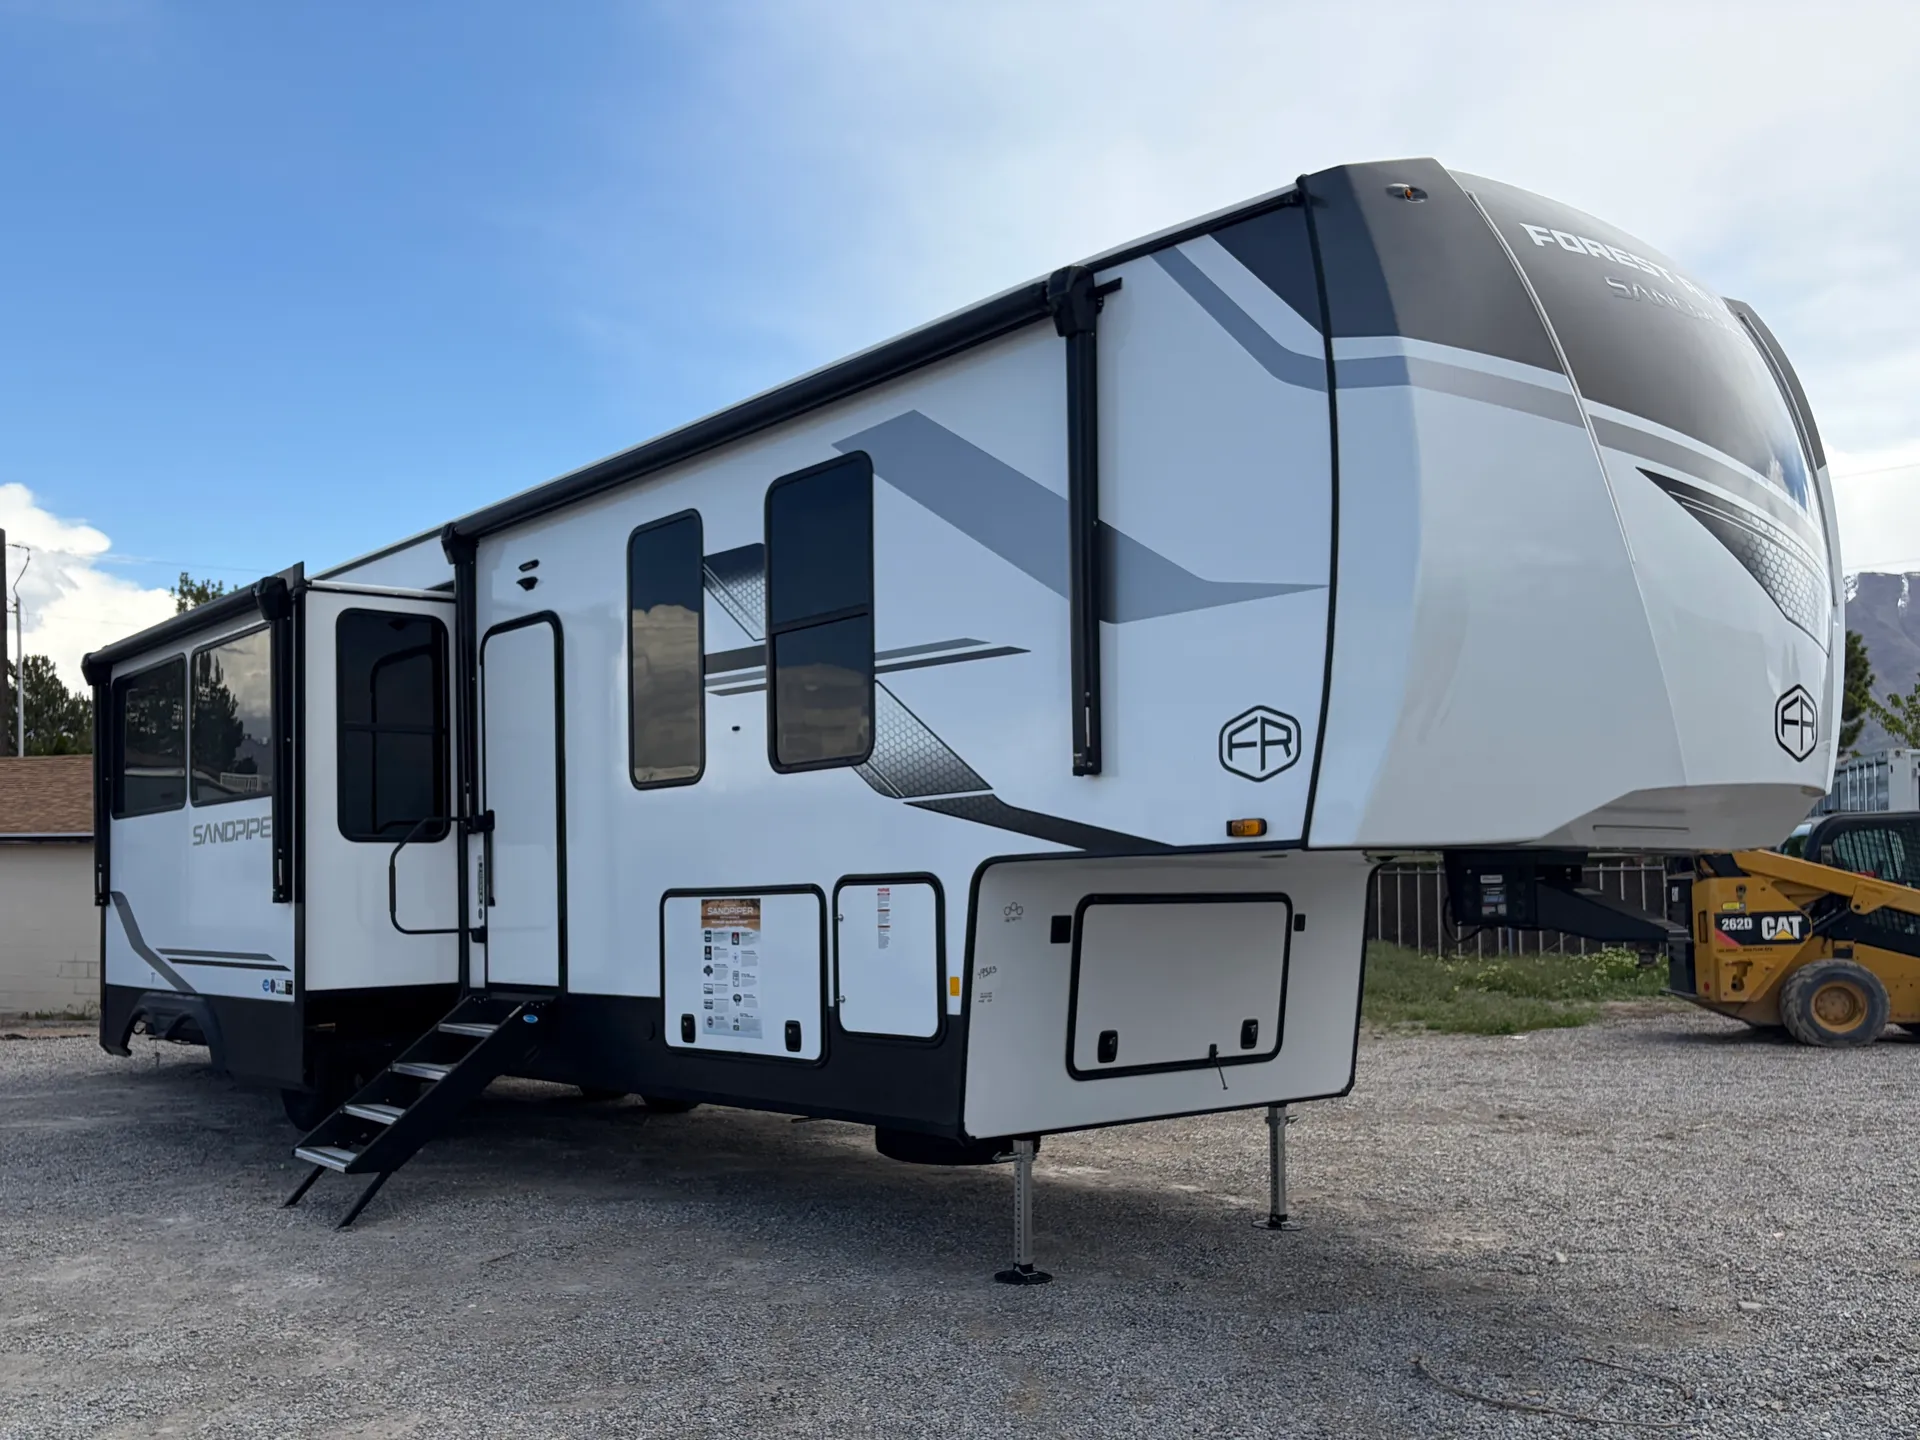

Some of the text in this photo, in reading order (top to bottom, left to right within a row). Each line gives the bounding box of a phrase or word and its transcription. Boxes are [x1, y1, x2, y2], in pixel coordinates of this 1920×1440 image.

[1519, 223, 1674, 284] FOREST
[193, 816, 272, 846] SANDPIPE
[707, 906, 754, 915] SANDPIPER
[1721, 916, 1802, 941] 262D CAT
